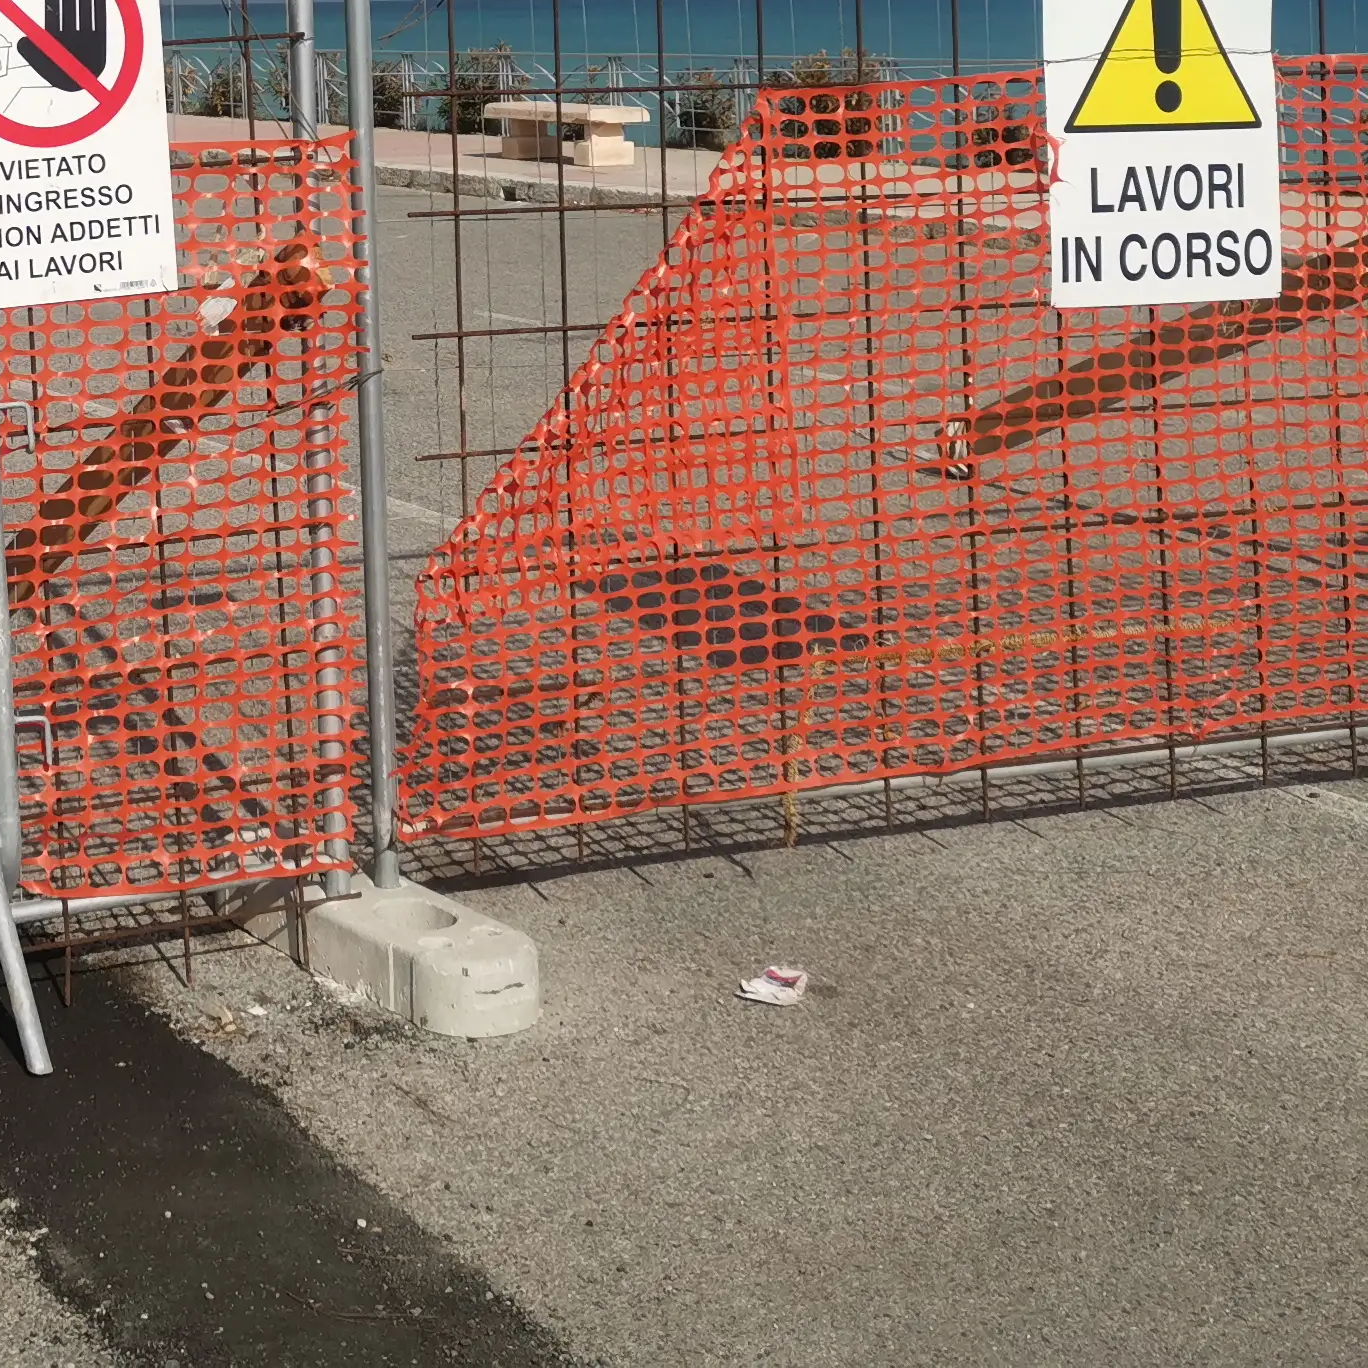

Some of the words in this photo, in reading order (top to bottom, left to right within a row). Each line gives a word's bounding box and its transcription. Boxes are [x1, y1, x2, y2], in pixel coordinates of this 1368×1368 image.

[0, 153, 106, 181] VIETATO
[1091, 163, 1245, 213] LAVORI
[51, 214, 160, 244] ADDETTI
[29, 250, 123, 279] LAVORI
[1061, 236, 1102, 283] IN
[1119, 228, 1273, 282] CORSO
